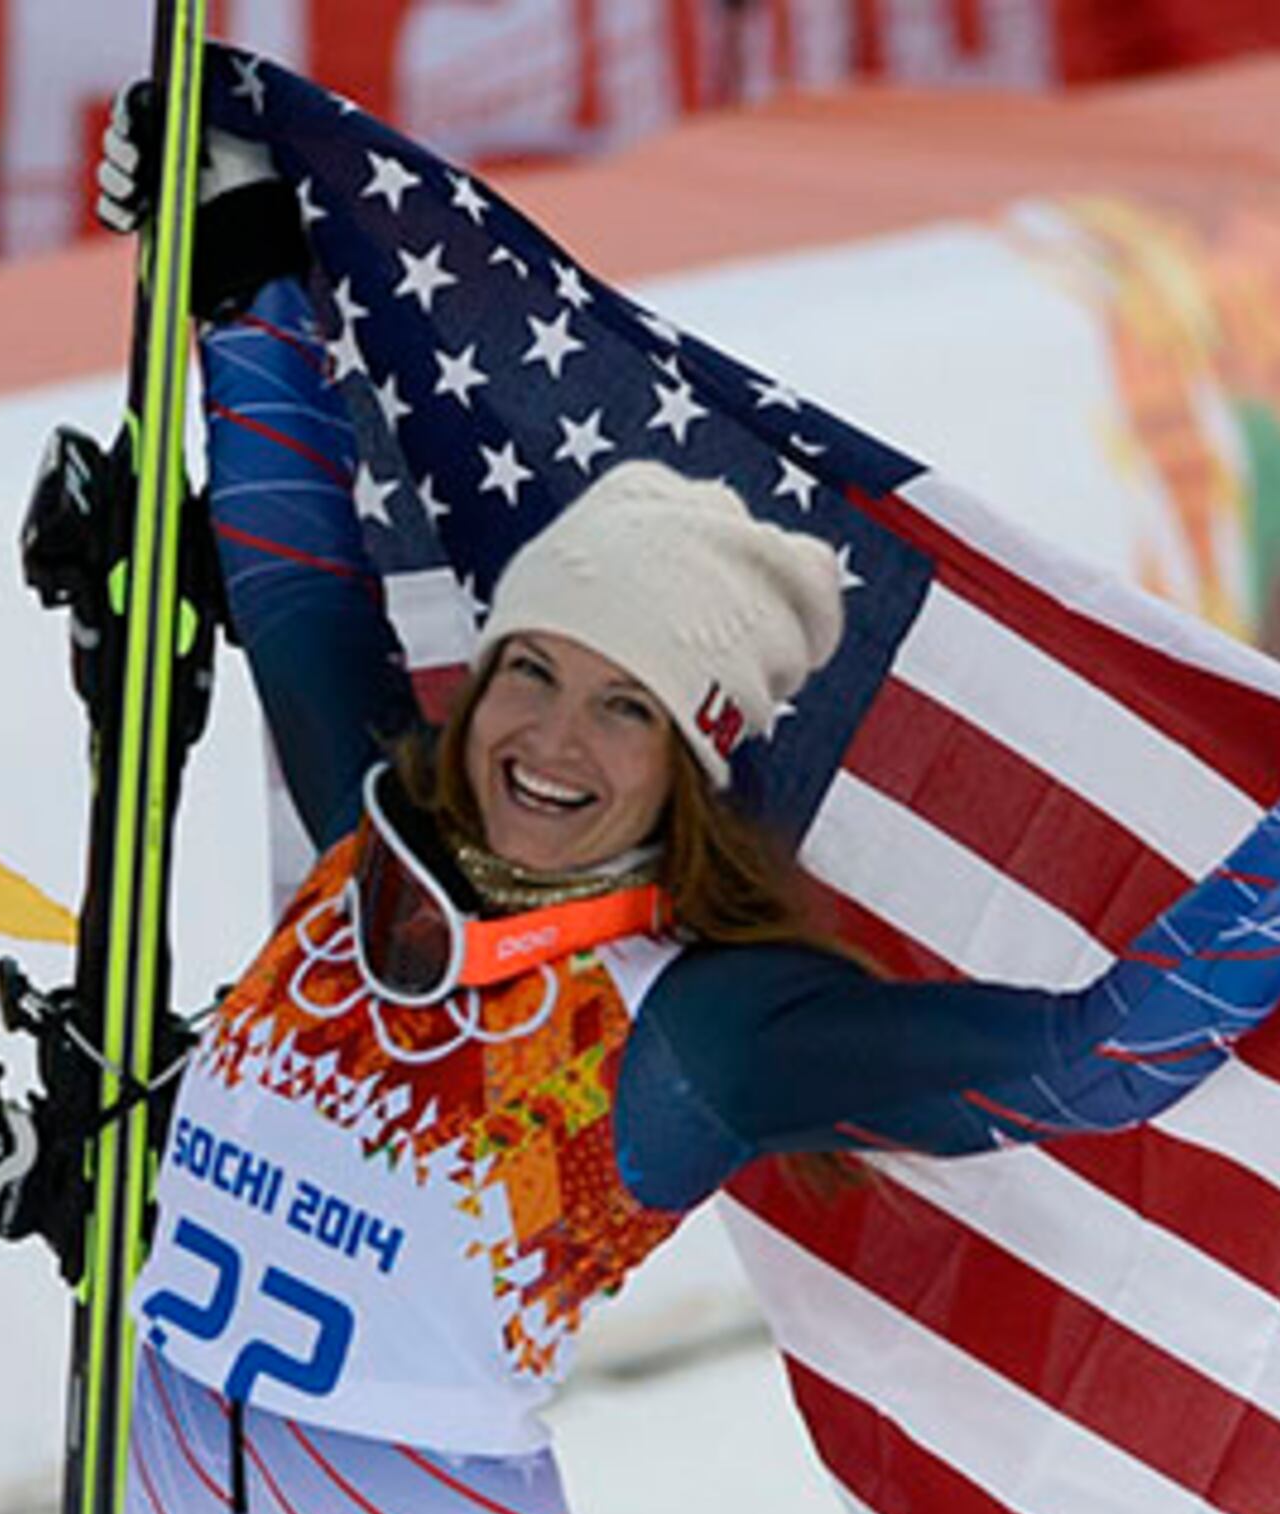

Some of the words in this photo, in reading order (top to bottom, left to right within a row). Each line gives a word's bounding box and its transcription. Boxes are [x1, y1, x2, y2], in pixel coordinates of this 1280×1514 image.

[172, 1117, 283, 1215] SOCHI
[287, 1180, 403, 1274] 2014
[141, 1217, 355, 1400] 22
